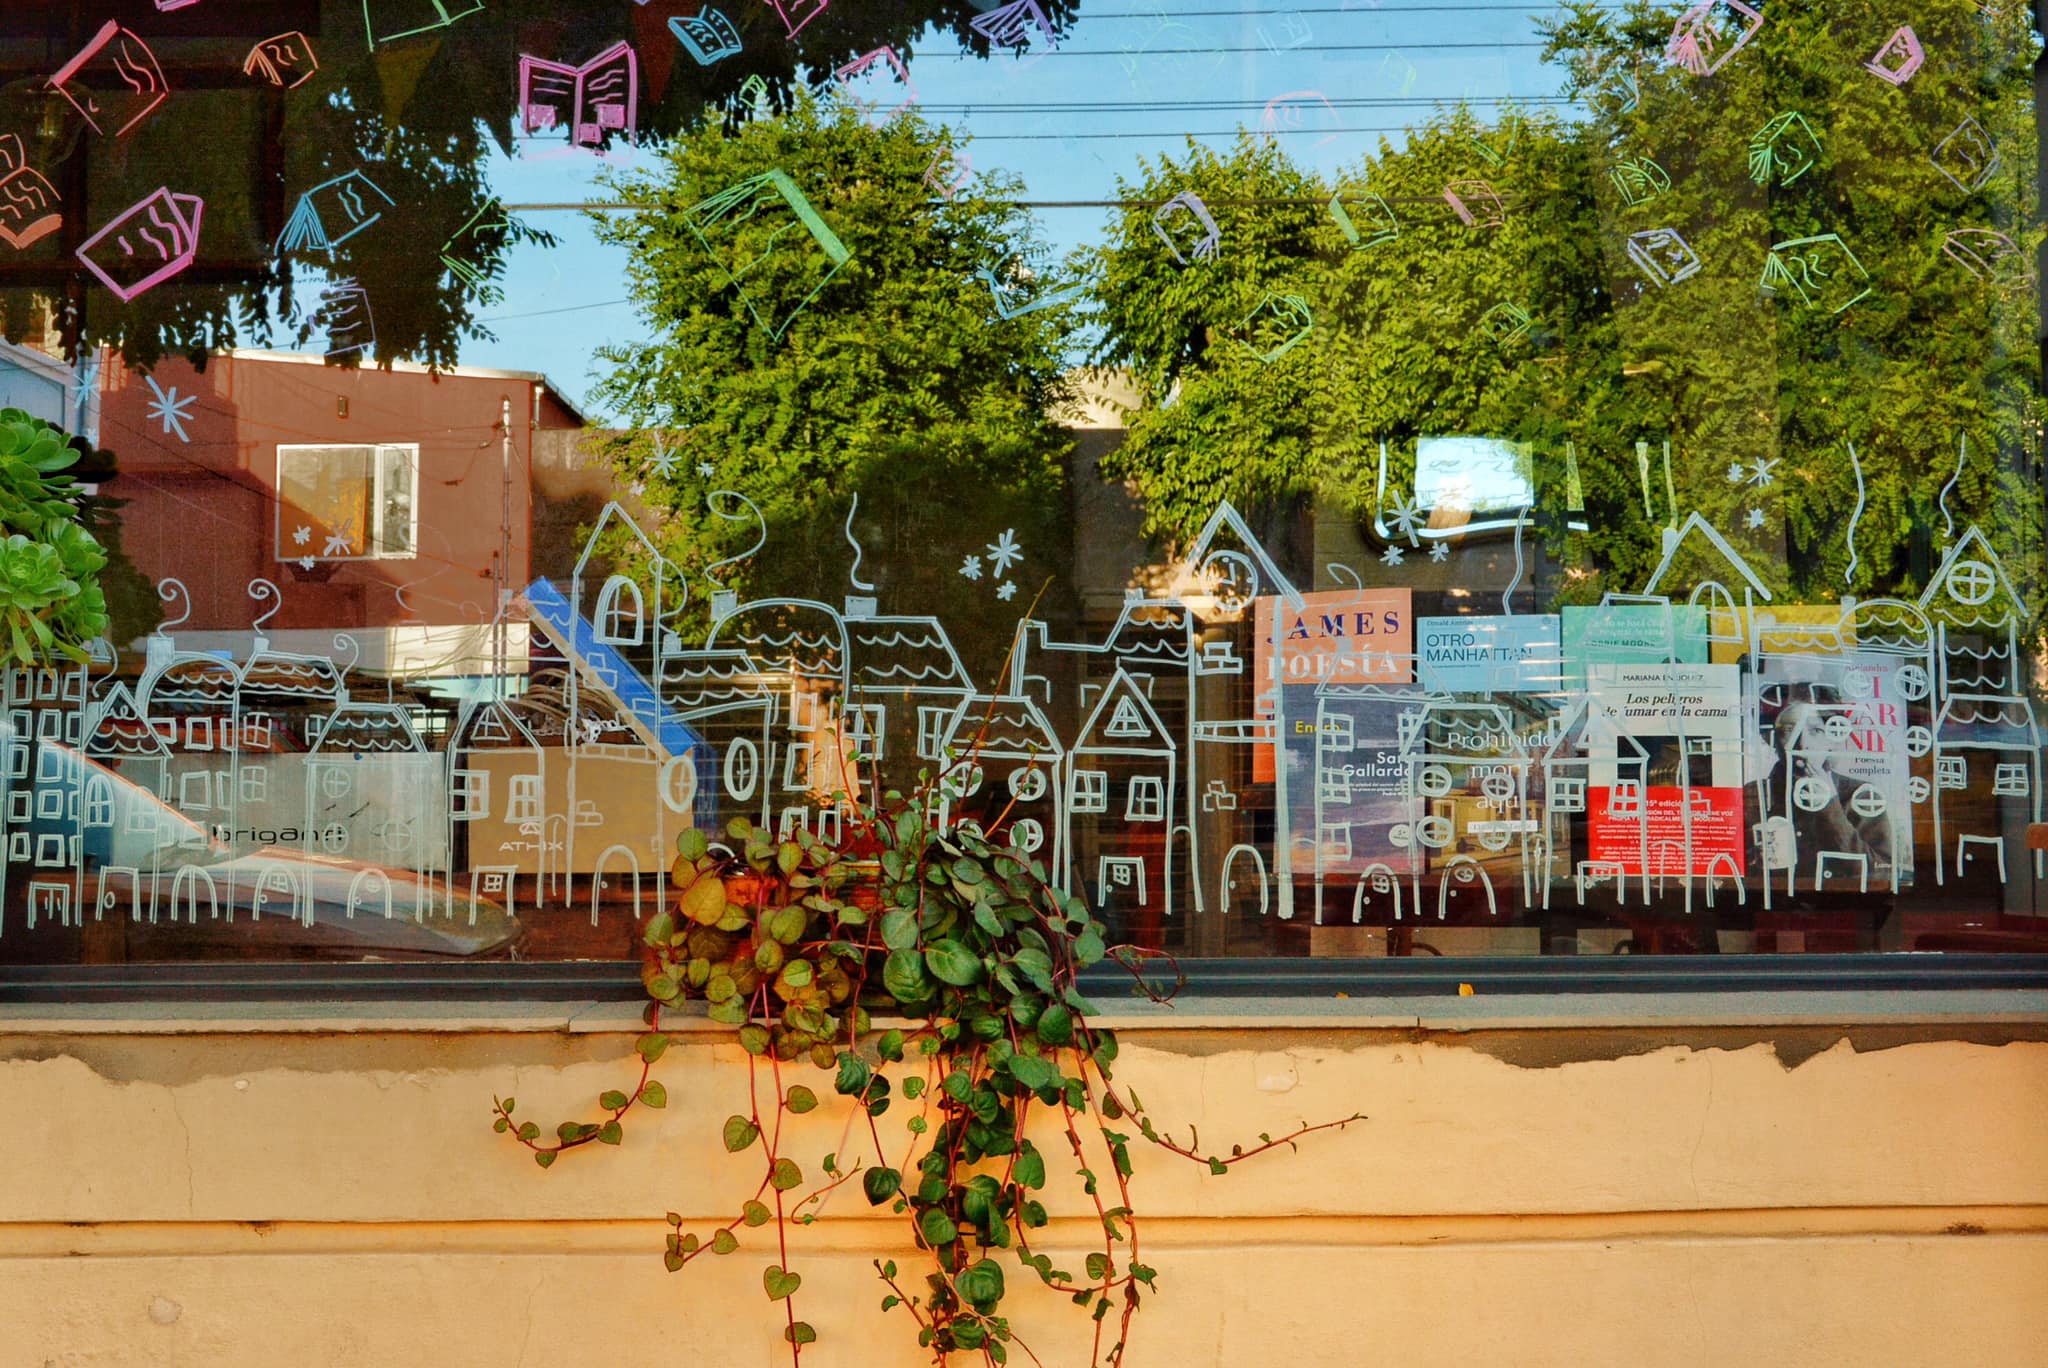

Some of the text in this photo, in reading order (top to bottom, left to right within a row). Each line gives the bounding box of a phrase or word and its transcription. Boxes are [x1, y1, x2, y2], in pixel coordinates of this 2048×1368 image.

[1266, 611, 1400, 644] AMES
[1426, 633, 1475, 647] OTRO
[1626, 693, 1650, 705] Los
[1623, 706, 1660, 718] umar
[1661, 708, 1678, 717] en
[1680, 705, 1692, 717] la
[1694, 708, 1729, 717] cama
[1447, 730, 1553, 749] Prohiido
[1376, 751, 1410, 764] Sar
[1848, 764, 1891, 776] completa
[1476, 795, 1520, 814] aqu
[1658, 799, 1682, 807] edició
